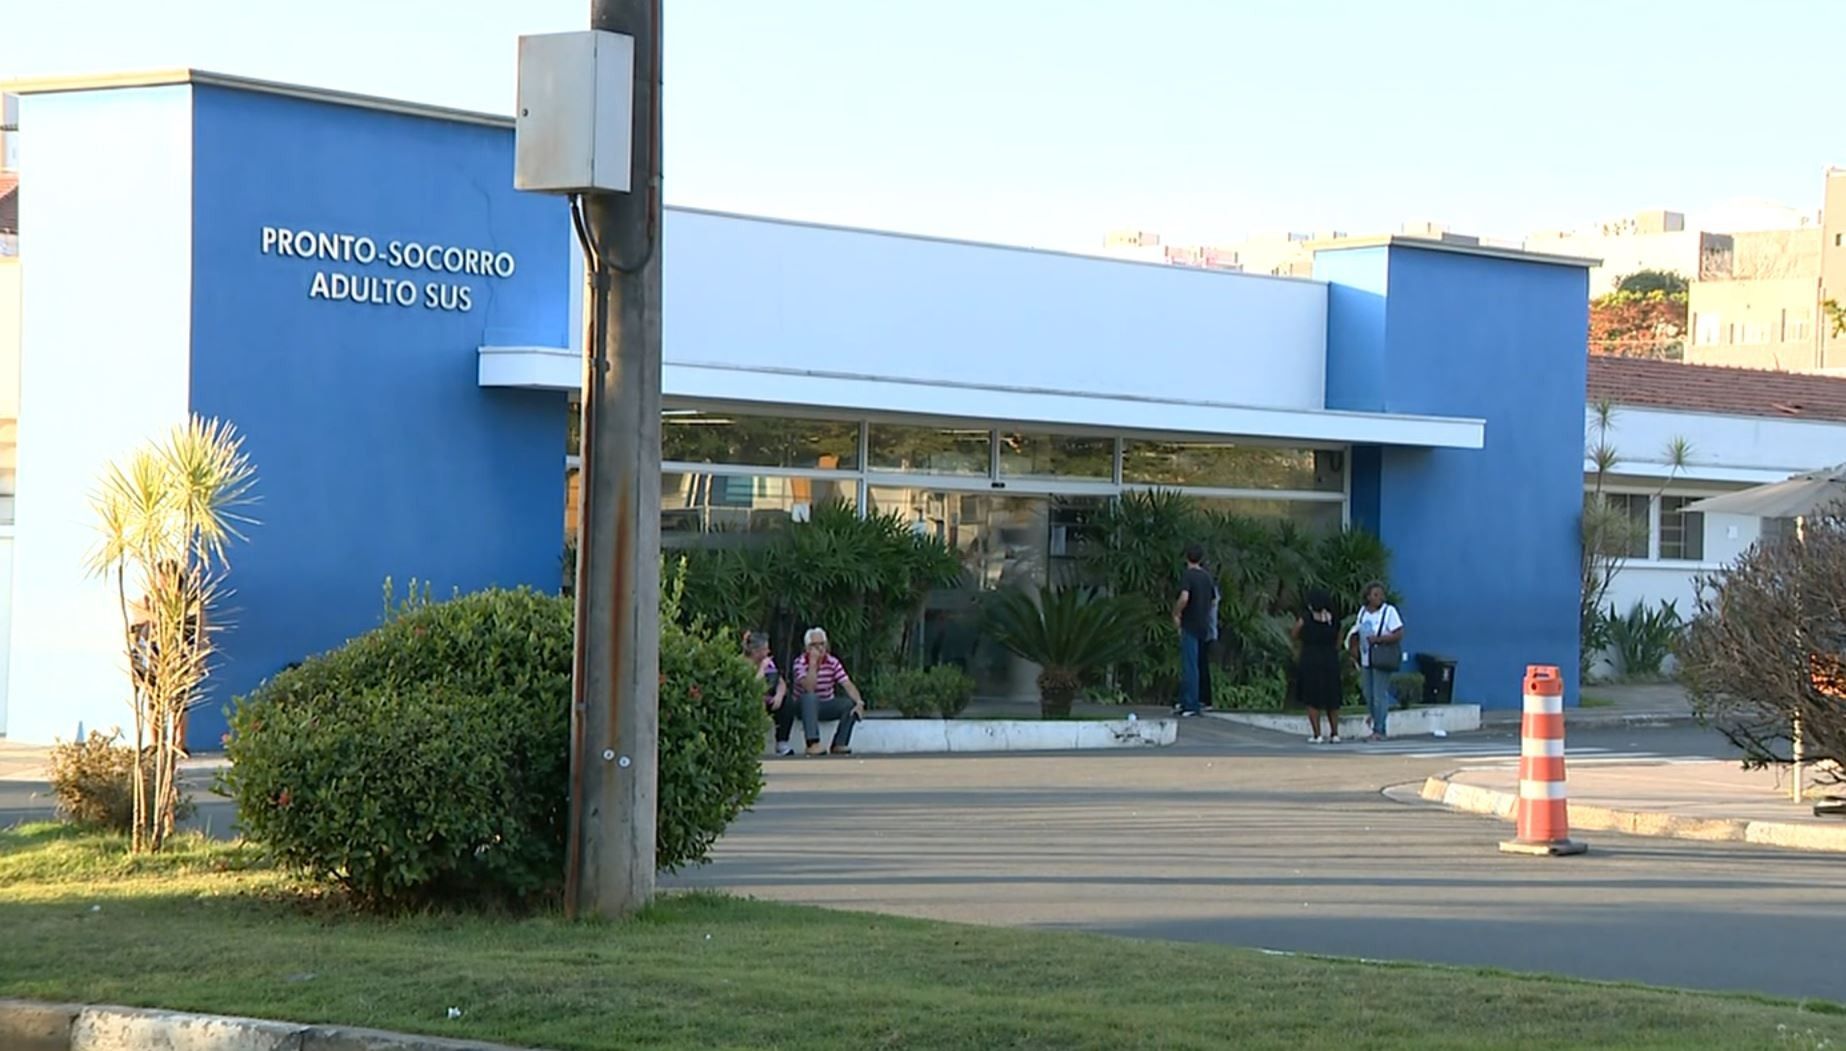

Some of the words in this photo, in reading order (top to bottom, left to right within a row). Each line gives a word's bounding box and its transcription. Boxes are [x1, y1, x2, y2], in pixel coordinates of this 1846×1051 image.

[261, 226, 515, 278] PRONTO-SOCORRO
[309, 271, 417, 306] ADULTO
[425, 282, 472, 312] SUS
